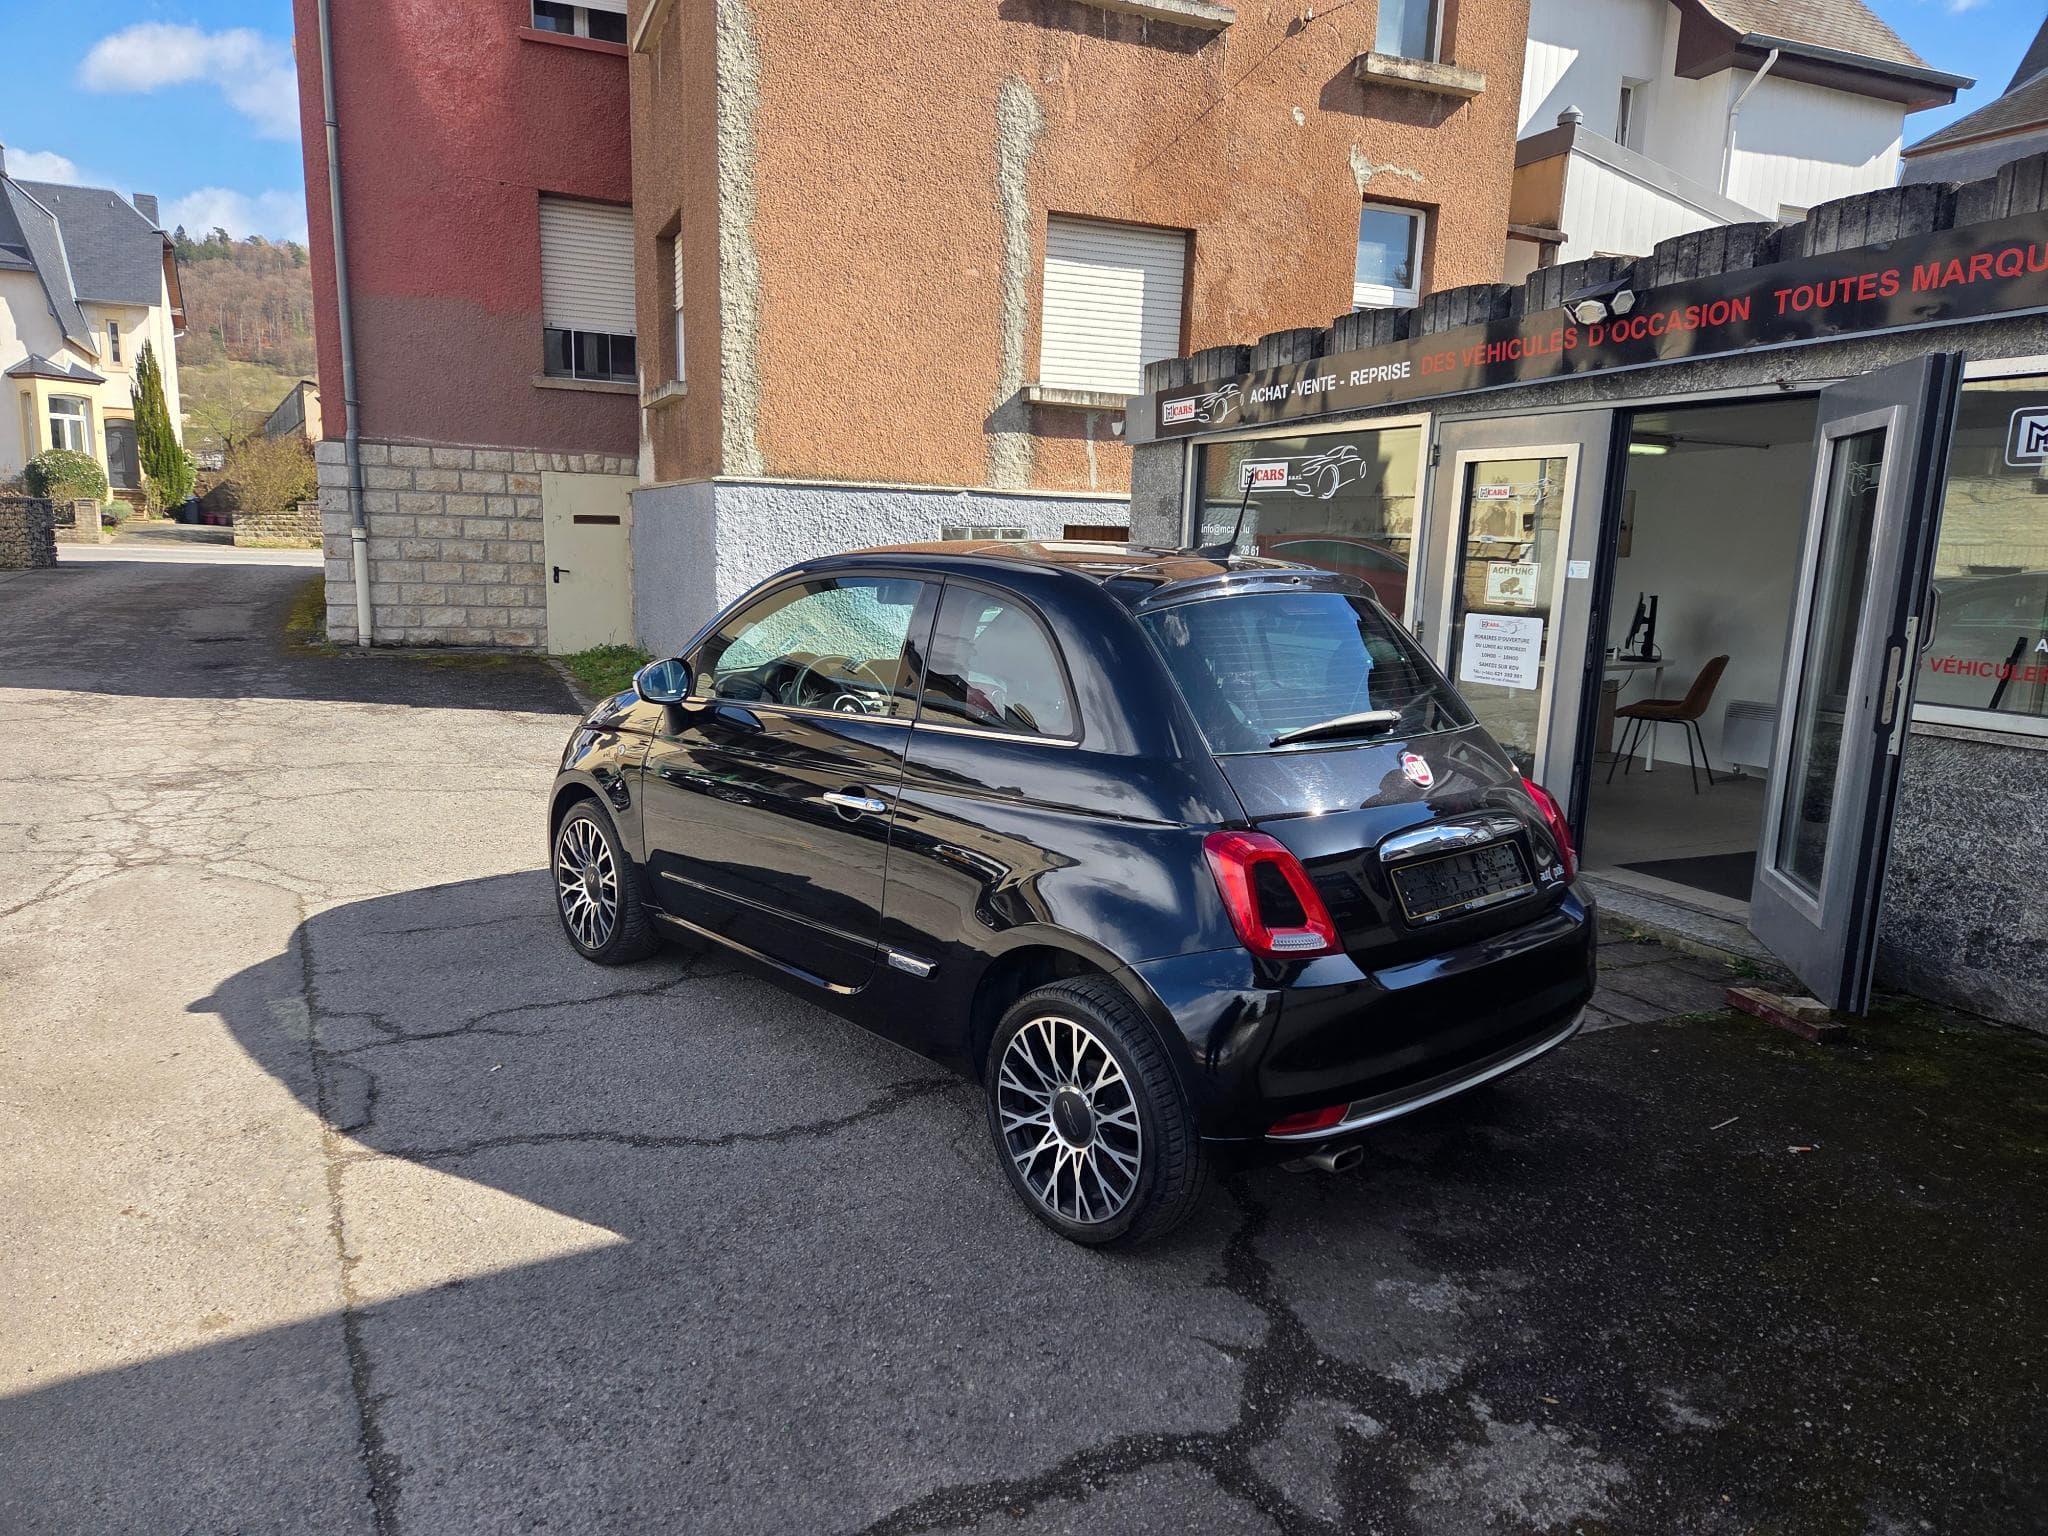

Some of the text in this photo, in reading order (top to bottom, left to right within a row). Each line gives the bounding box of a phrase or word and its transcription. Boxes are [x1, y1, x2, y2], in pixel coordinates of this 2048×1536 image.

[1250, 383, 1288, 404] ACHAT
[1296, 374, 1336, 396] VENTE
[1350, 361, 1410, 386] REPRISE
[1421, 351, 1456, 376] DES
[1462, 327, 1578, 366] VÉHICULES
[1589, 296, 1751, 347] D'OCCASION
[1774, 269, 1900, 314] TOUTES
[1492, 566, 1534, 576] ACHTUNG
